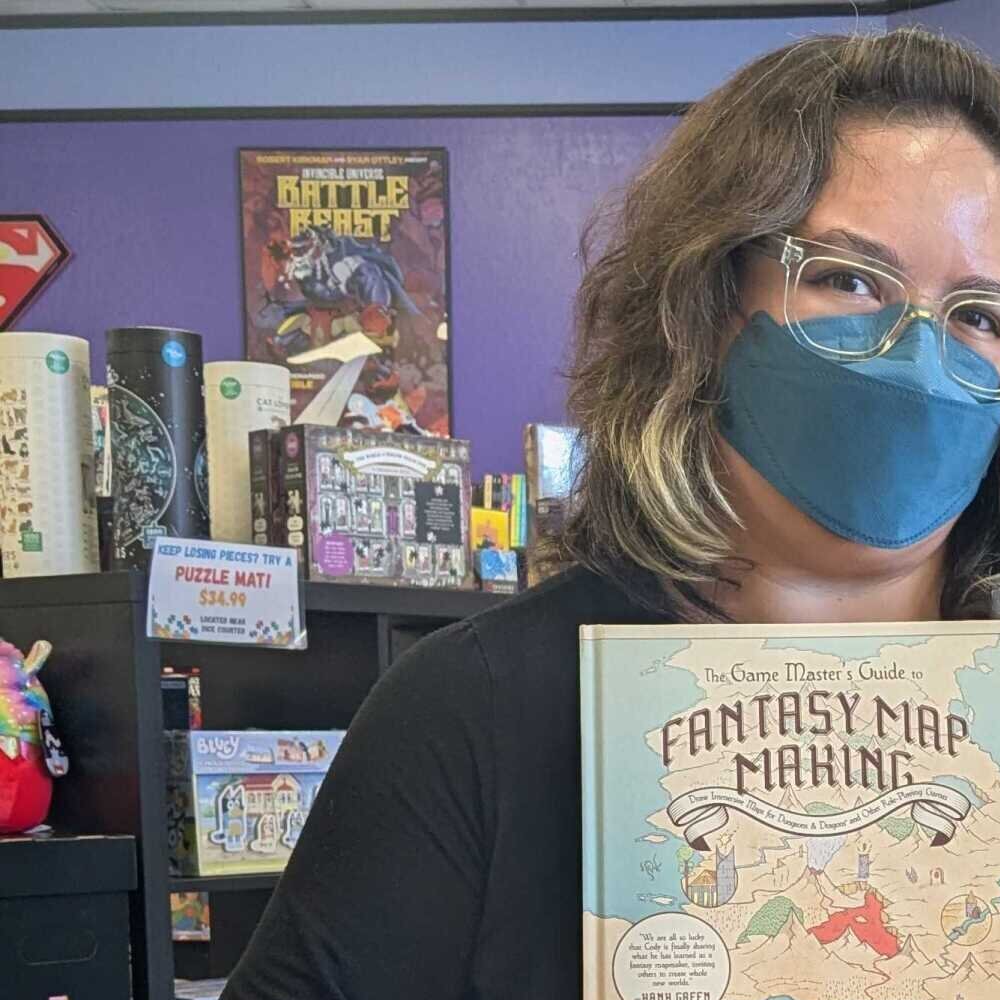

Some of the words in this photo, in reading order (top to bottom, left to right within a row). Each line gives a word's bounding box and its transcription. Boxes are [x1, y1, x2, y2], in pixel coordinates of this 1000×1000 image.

[277, 175, 410, 209] BATTLE
[289, 208, 400, 242] BEAST
[158, 544, 182, 557] KEEP
[184, 546, 216, 560] LOSING
[219, 550, 260, 564] PIECES?
[263, 554, 281, 566] TRY
[285, 557, 292, 567] A
[175, 566, 230, 586] PUZZLE
[234, 570, 272, 589] MAT!
[199, 586, 247, 608] $34.99
[705, 667, 725, 682] The
[730, 663, 779, 682] Game
[785, 662, 853, 682] Master's
[858, 661, 905, 681] Guide
[911, 671, 924, 680] to
[662, 690, 861, 767] FANTASY
[873, 694, 969, 759] MAP
[735, 743, 914, 795] MAKING
[810, 821, 818, 830] &
[849, 813, 862, 824] and
[861, 805, 882, 818] Other
[644, 942, 661, 952] Cody
[671, 942, 691, 952] finally
[669, 933, 677, 942] all
